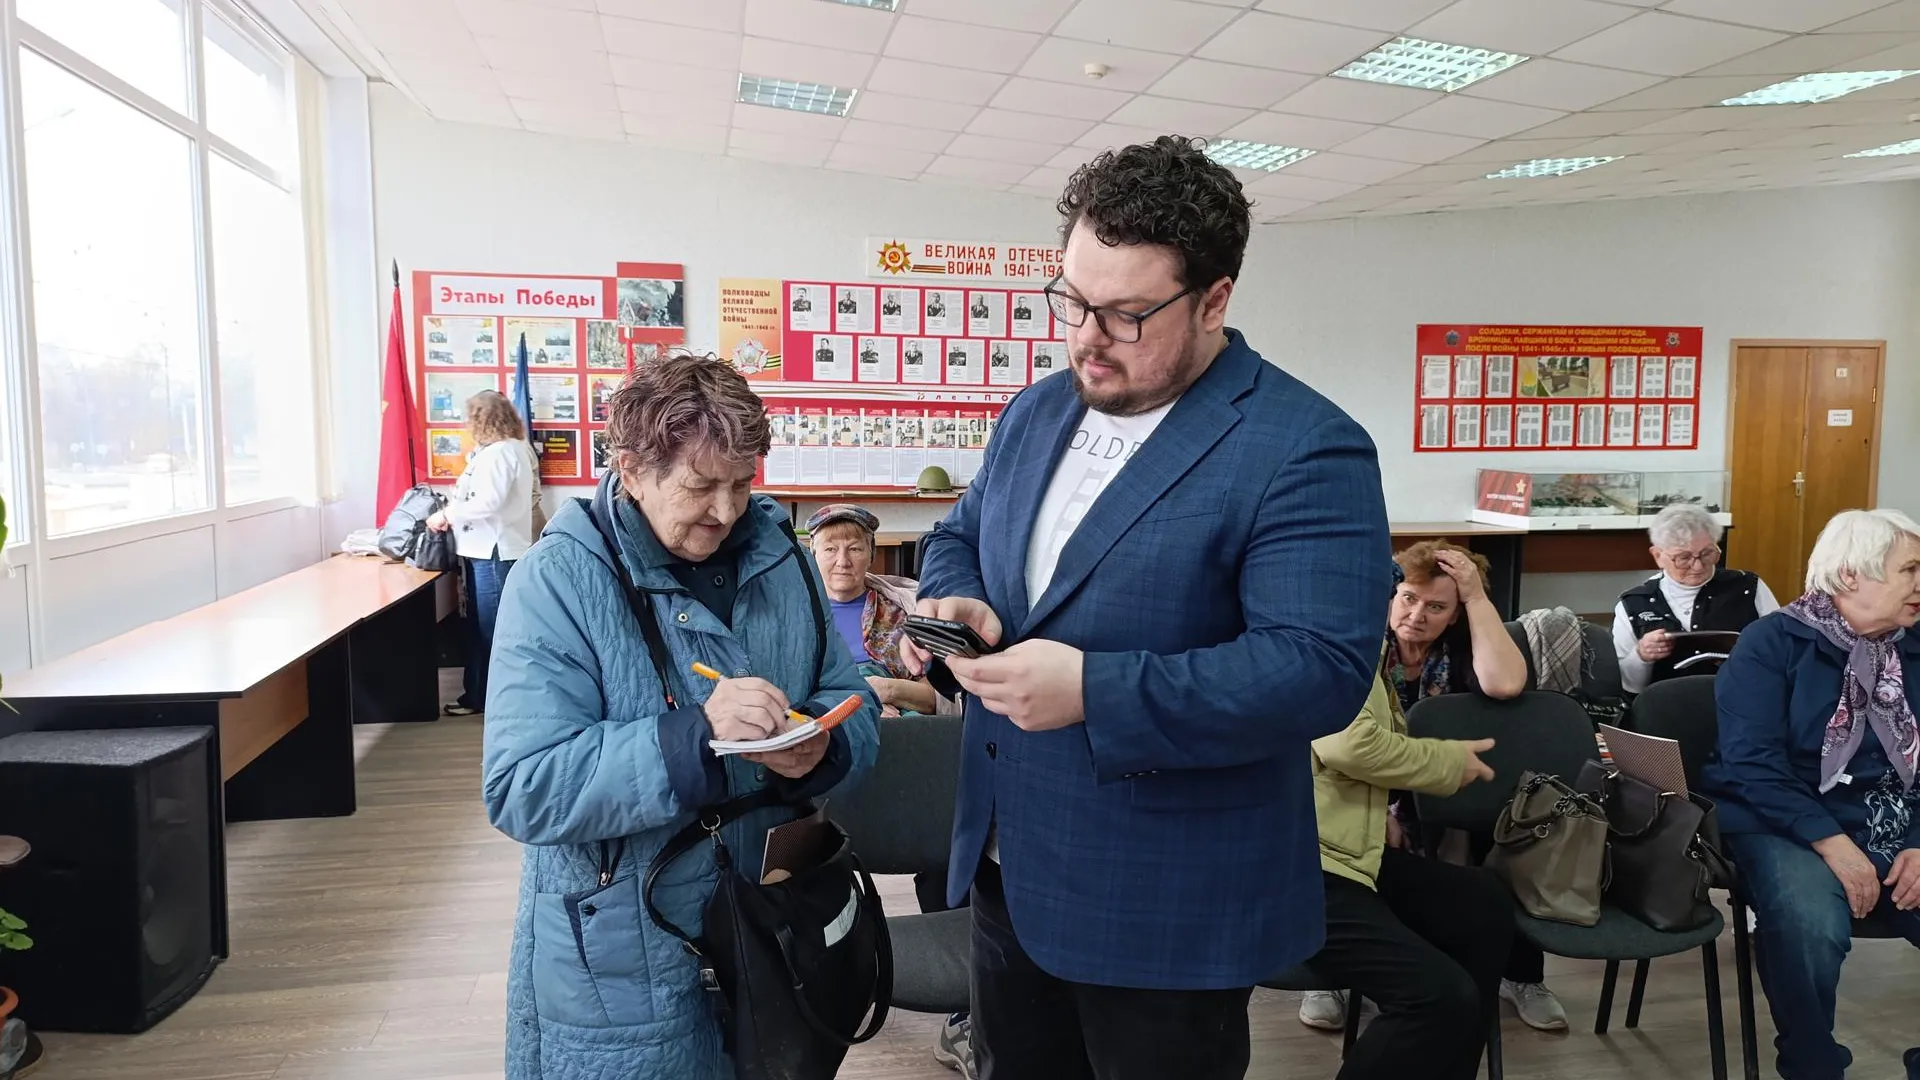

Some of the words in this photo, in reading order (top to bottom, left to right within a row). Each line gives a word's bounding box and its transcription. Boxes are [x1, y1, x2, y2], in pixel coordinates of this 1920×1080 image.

[925, 244, 996, 261] ВЕЛИКАЯ
[947, 259, 992, 276] ВОЙНА
[440, 286, 504, 305] Этапы
[516, 288, 596, 308] Победы
[722, 289, 770, 297] ПОЛКОВОДЦЫ
[722, 306, 777, 315] ОТЕЧЕСТВЕННОЙ
[1492, 344, 1519, 352] ВОЙНЫ
